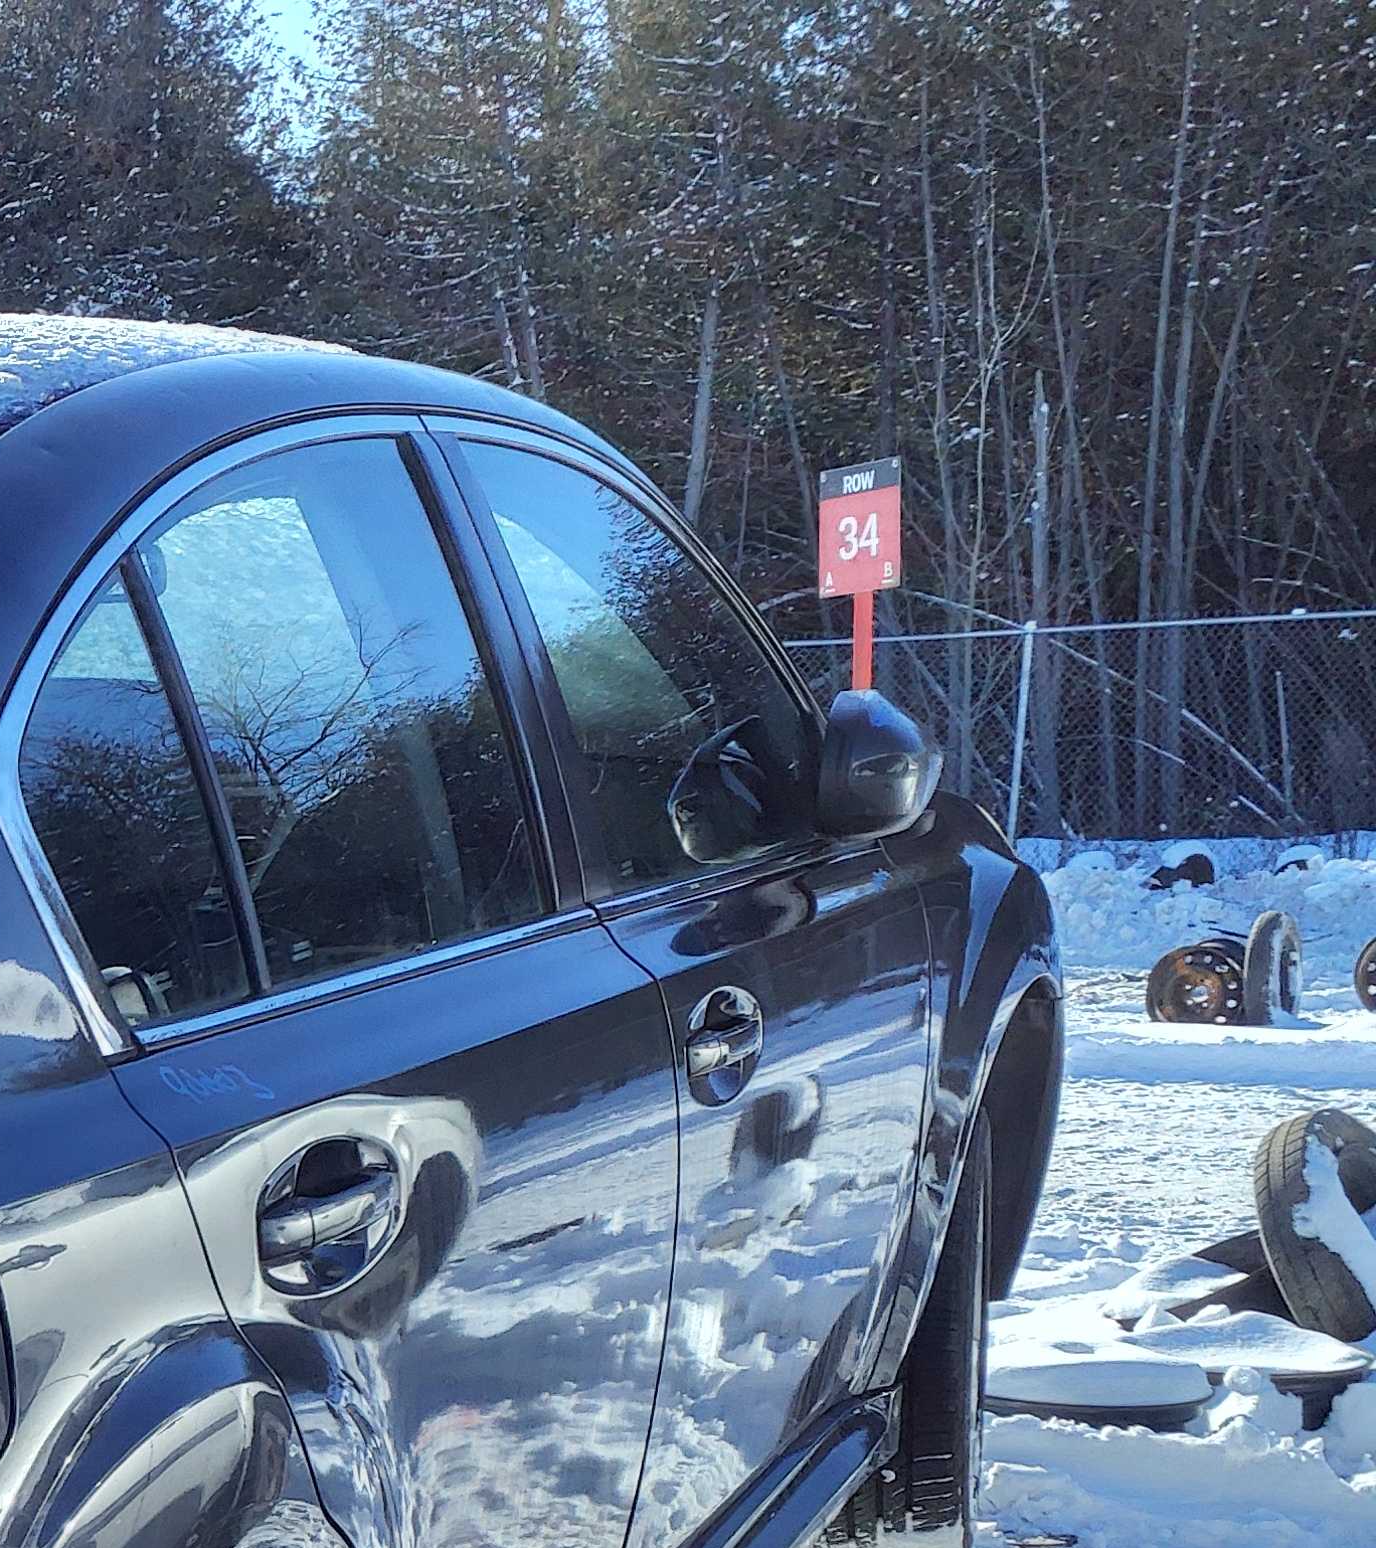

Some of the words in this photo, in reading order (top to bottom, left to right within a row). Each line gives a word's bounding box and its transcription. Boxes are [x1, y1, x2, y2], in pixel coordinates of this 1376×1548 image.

[842, 470, 876, 494] ROW
[838, 512, 880, 560] 34
[883, 562, 893, 577] B
[825, 572, 833, 587] A
